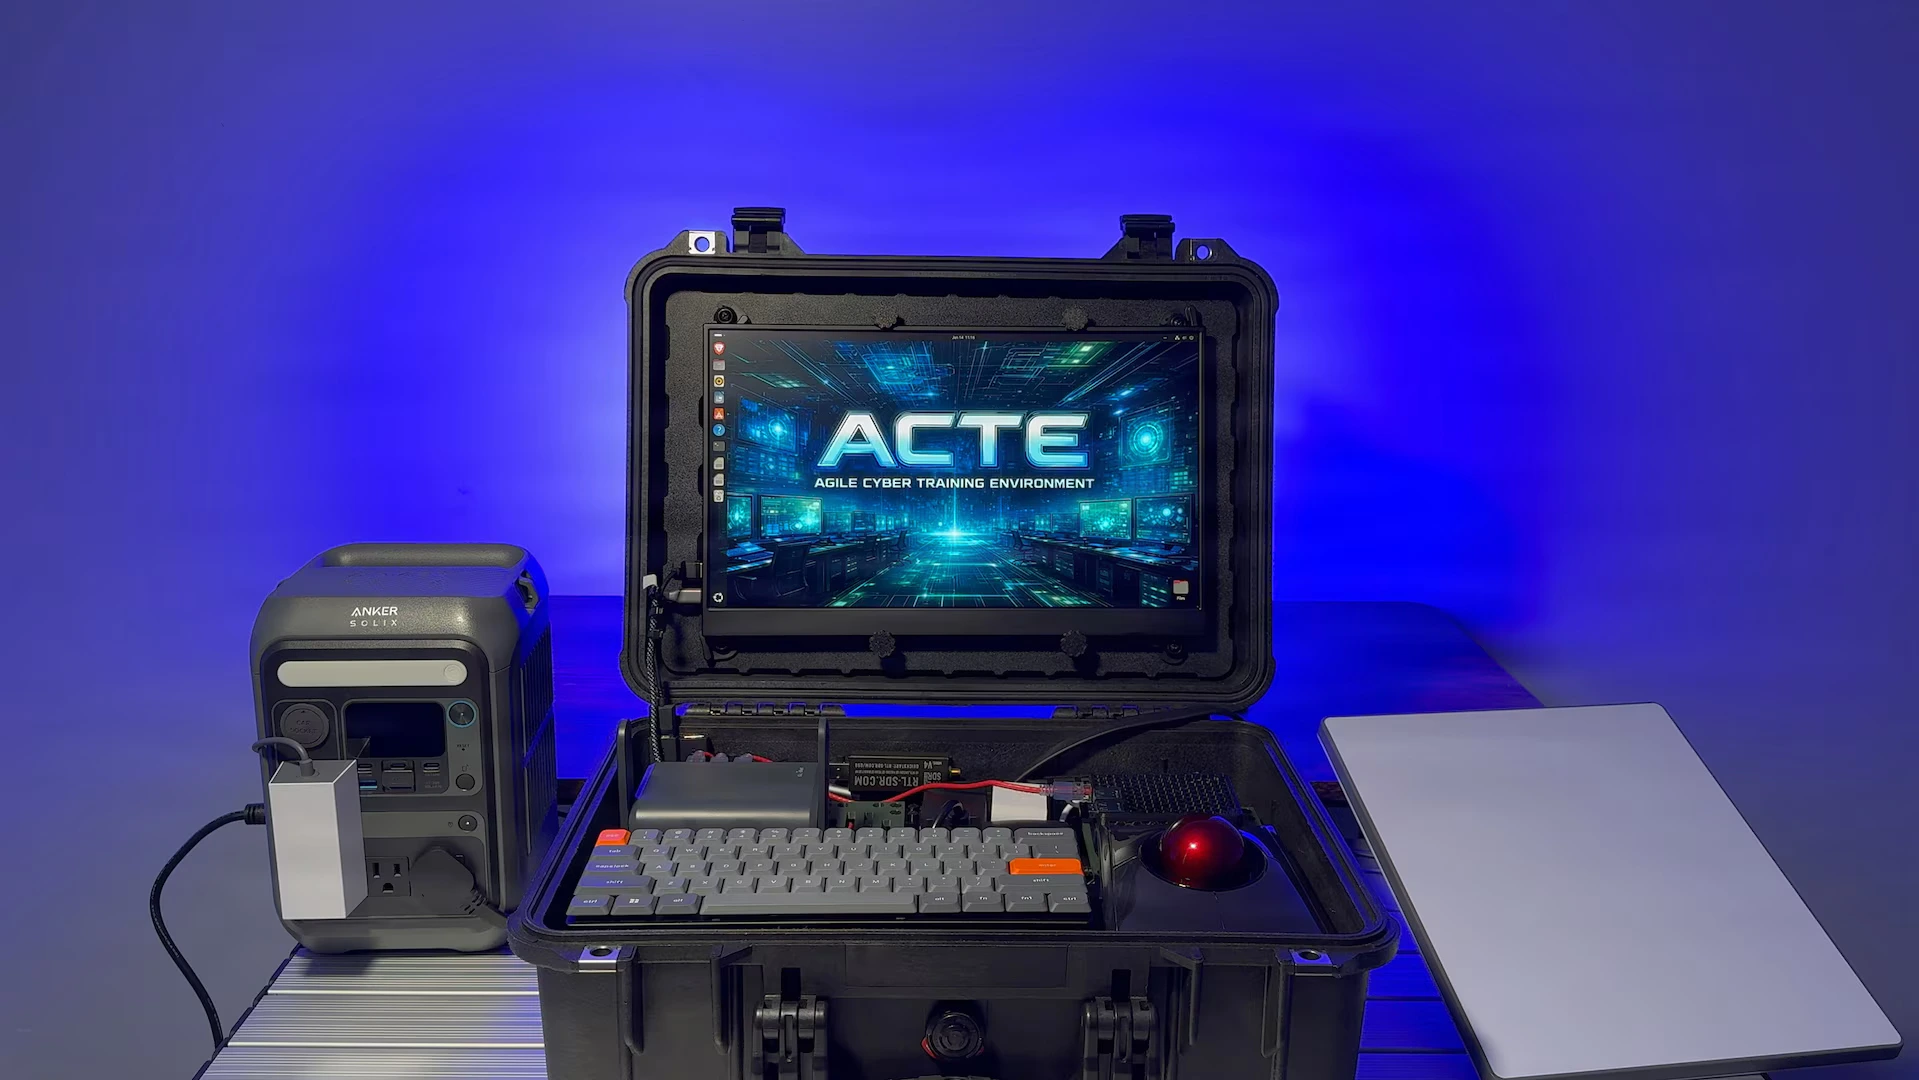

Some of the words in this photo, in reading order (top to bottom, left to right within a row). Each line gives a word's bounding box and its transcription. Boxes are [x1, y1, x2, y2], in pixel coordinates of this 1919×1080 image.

[816, 411, 1090, 469] ACTE
[814, 478, 858, 489] AGILE
[862, 478, 912, 489] CYBER
[916, 478, 985, 489] TRAINING
[989, 478, 1095, 489] ENVIRONMENT
[351, 606, 399, 617] ANKER
[350, 619, 398, 627] SOLIX
[854, 775, 919, 787] RTL-SDR.COM
